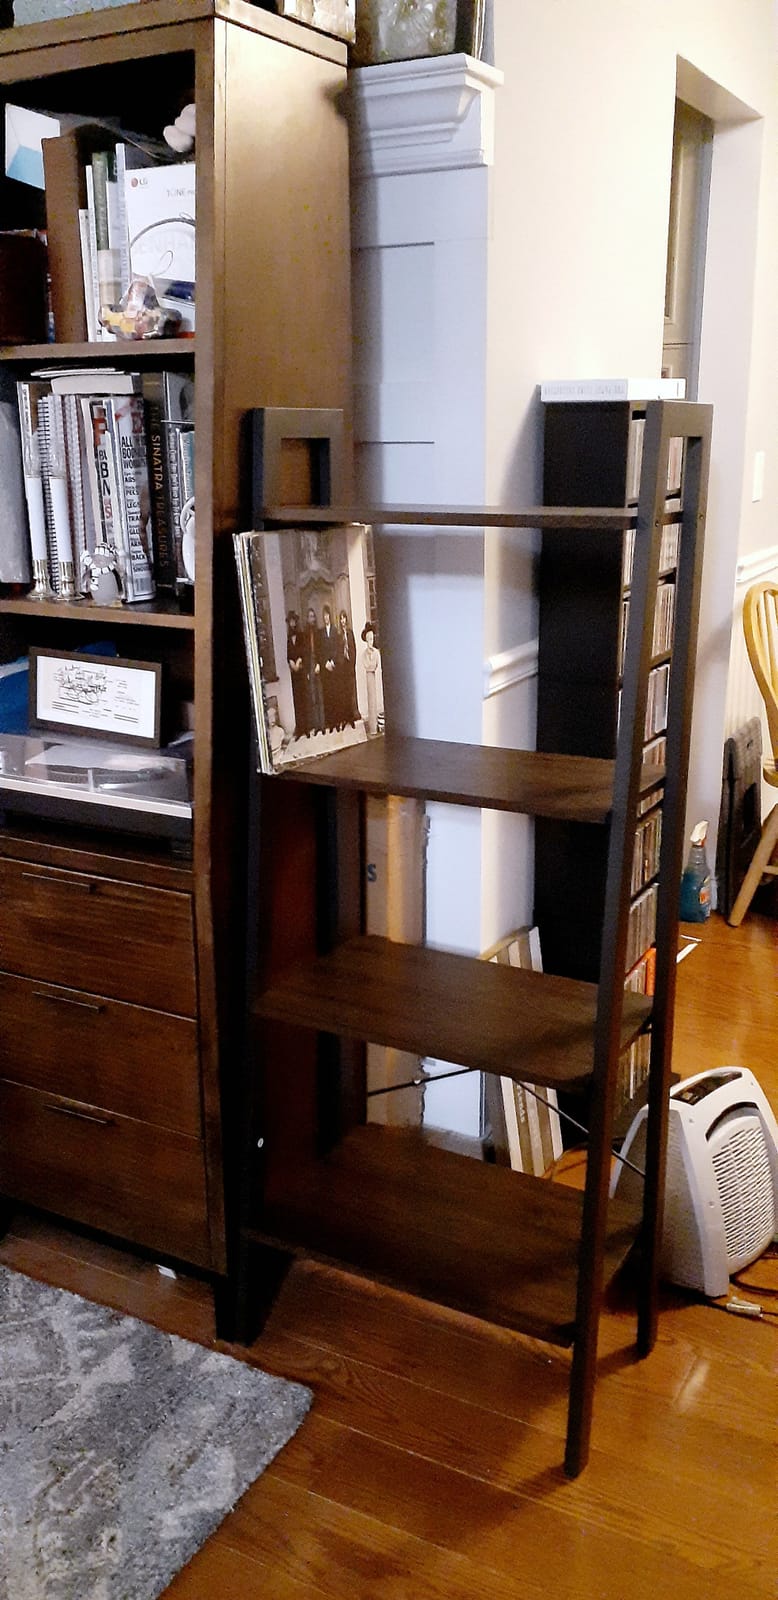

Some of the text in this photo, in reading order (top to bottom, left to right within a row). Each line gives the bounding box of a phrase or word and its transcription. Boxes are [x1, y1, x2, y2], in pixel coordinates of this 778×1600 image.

[122, 436, 133, 447] ALL
[152, 435, 164, 489] SINATRA
[367, 863, 377, 882] S
